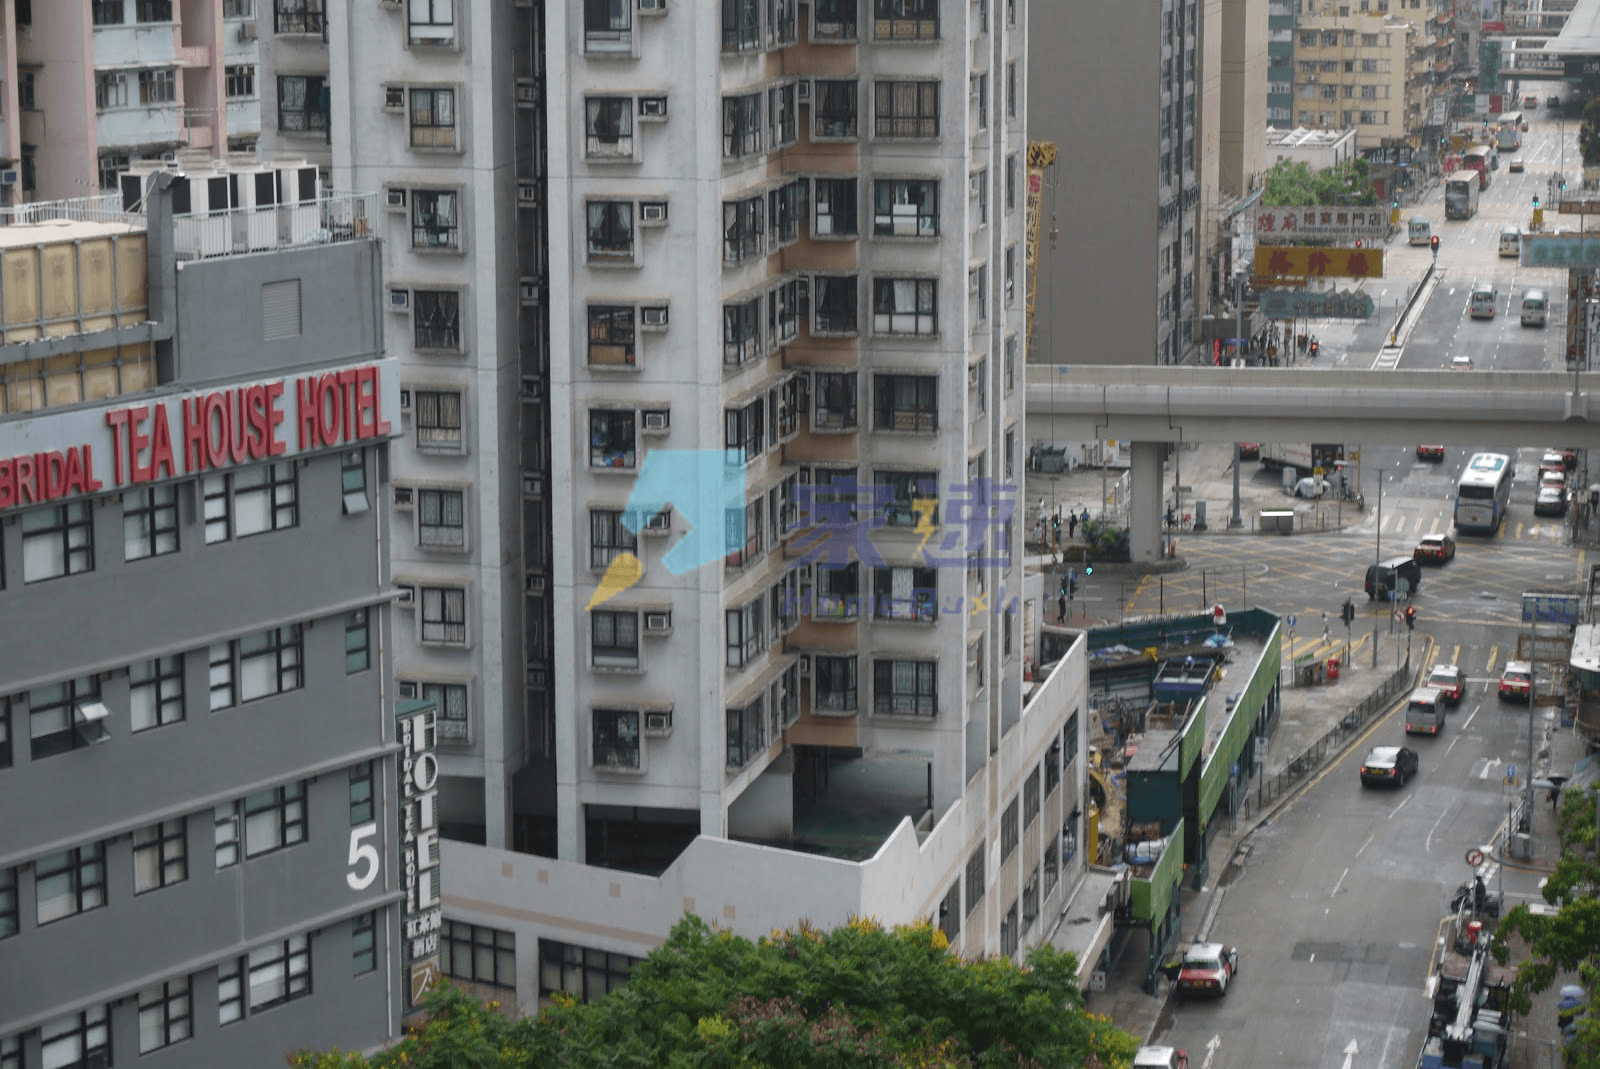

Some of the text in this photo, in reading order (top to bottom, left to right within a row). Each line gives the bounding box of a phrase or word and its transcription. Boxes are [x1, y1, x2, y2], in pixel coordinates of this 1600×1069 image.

[0, 366, 392, 508] BRIDAL TEA HOUSE HOTEL
[404, 803, 415, 844] TEA
[412, 709, 441, 911] HOTEL
[346, 822, 379, 891] 5
[405, 848, 416, 915] HOUSE
